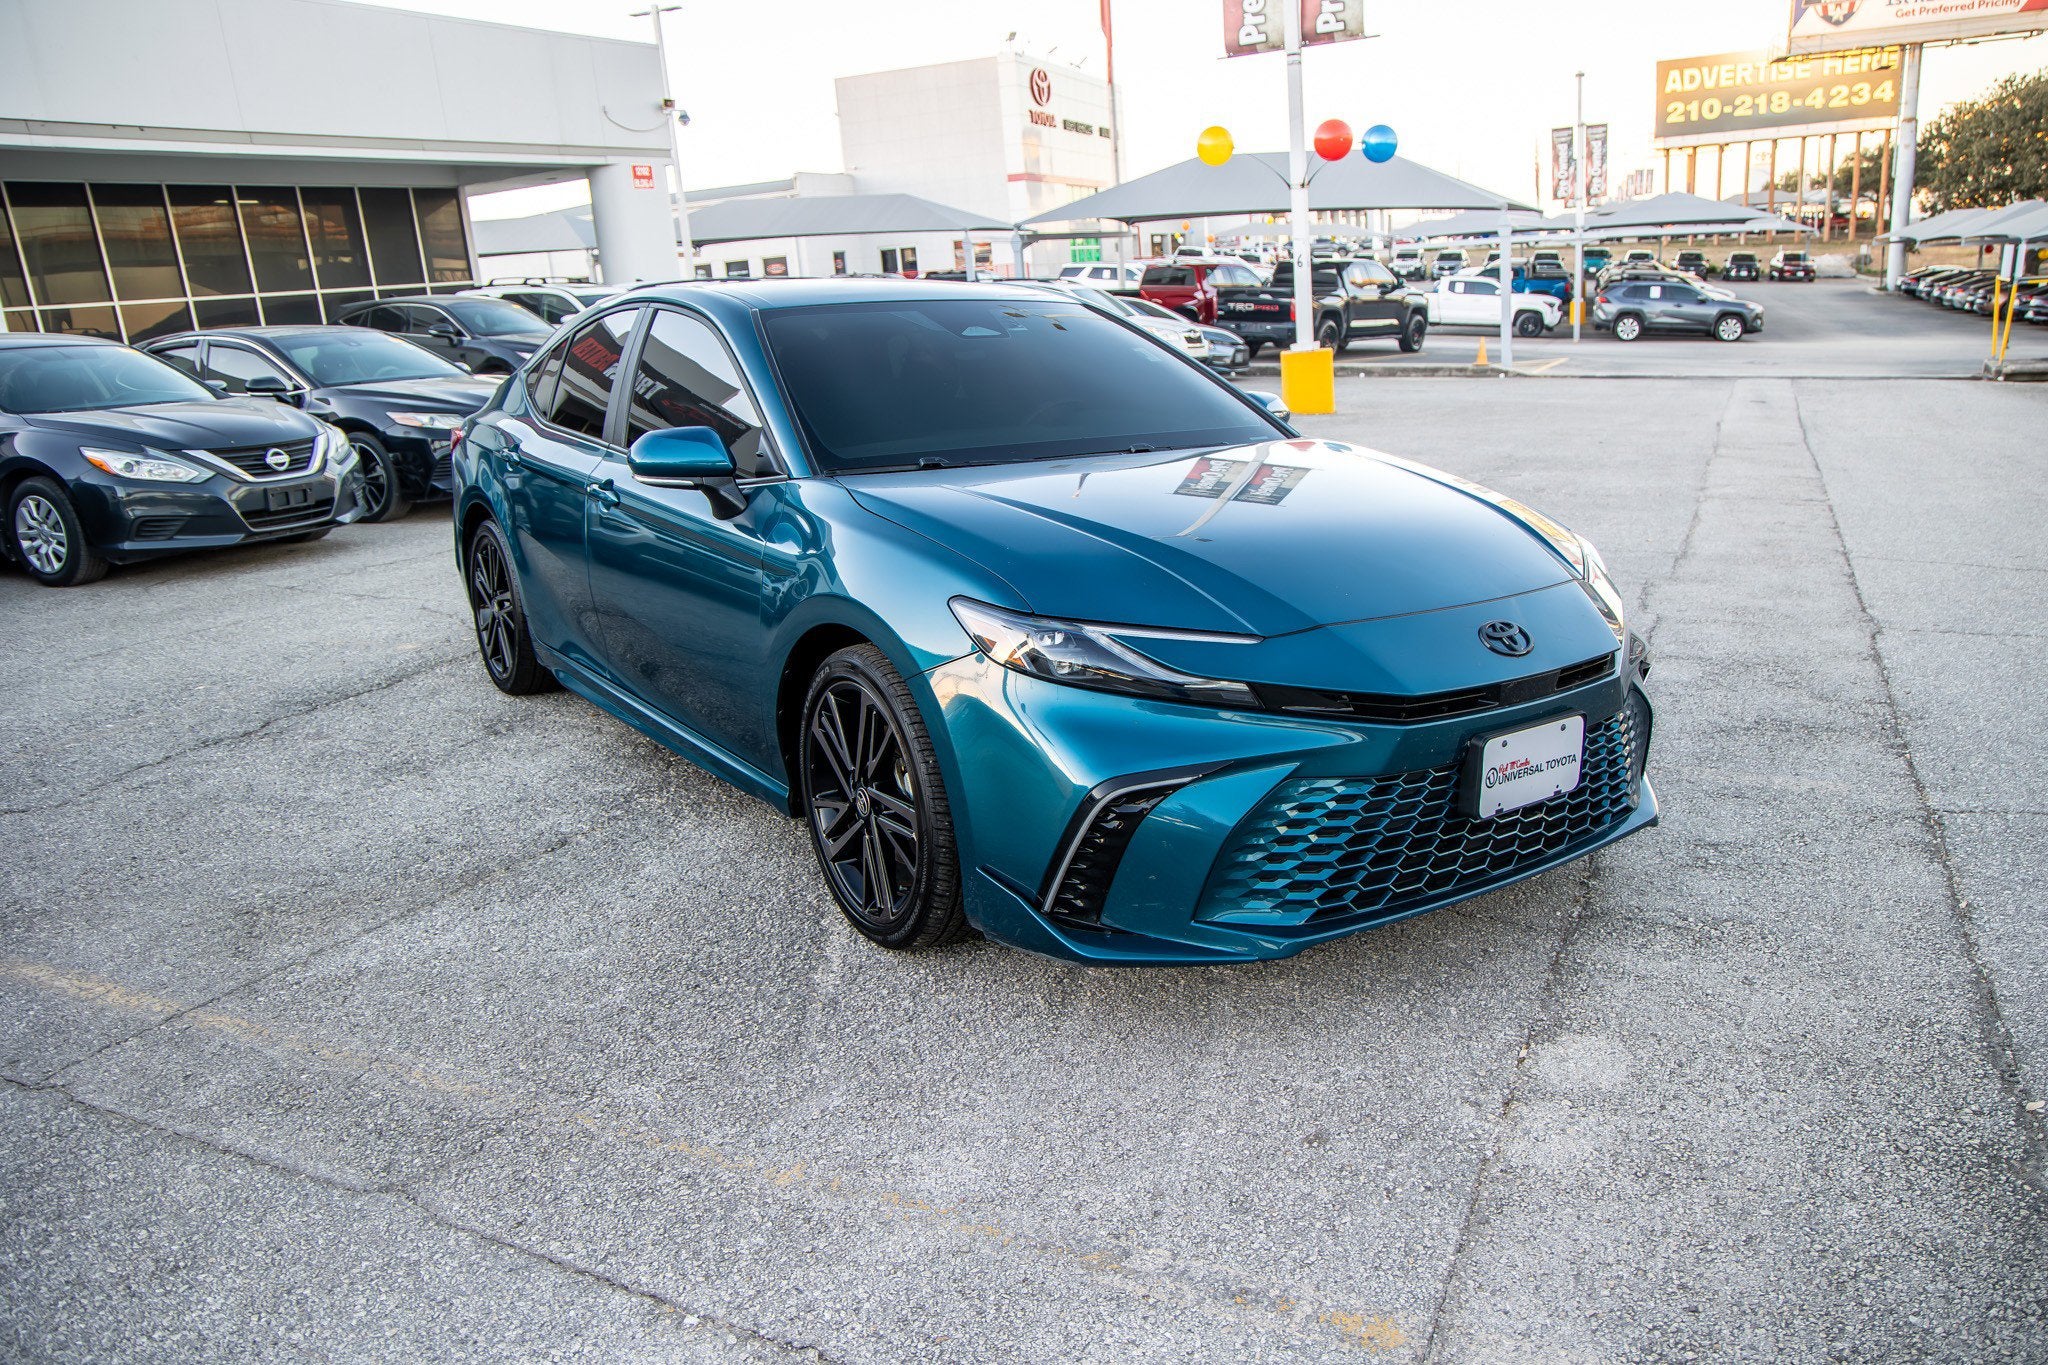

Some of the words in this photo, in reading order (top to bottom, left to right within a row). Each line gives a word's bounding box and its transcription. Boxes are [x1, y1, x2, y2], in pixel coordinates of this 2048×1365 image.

[1316, 0, 1346, 34] Pr
[1895, 8, 1916, 18] Get
[1919, 1, 1975, 15] Preferred
[1978, 0, 2021, 8] Pricing
[1664, 60, 1811, 93] ADVERTISE
[1665, 80, 1895, 123] 210-218-4234
[1498, 763, 1544, 785] UNIVERSAL
[1546, 754, 1577, 771] TOYOTA
